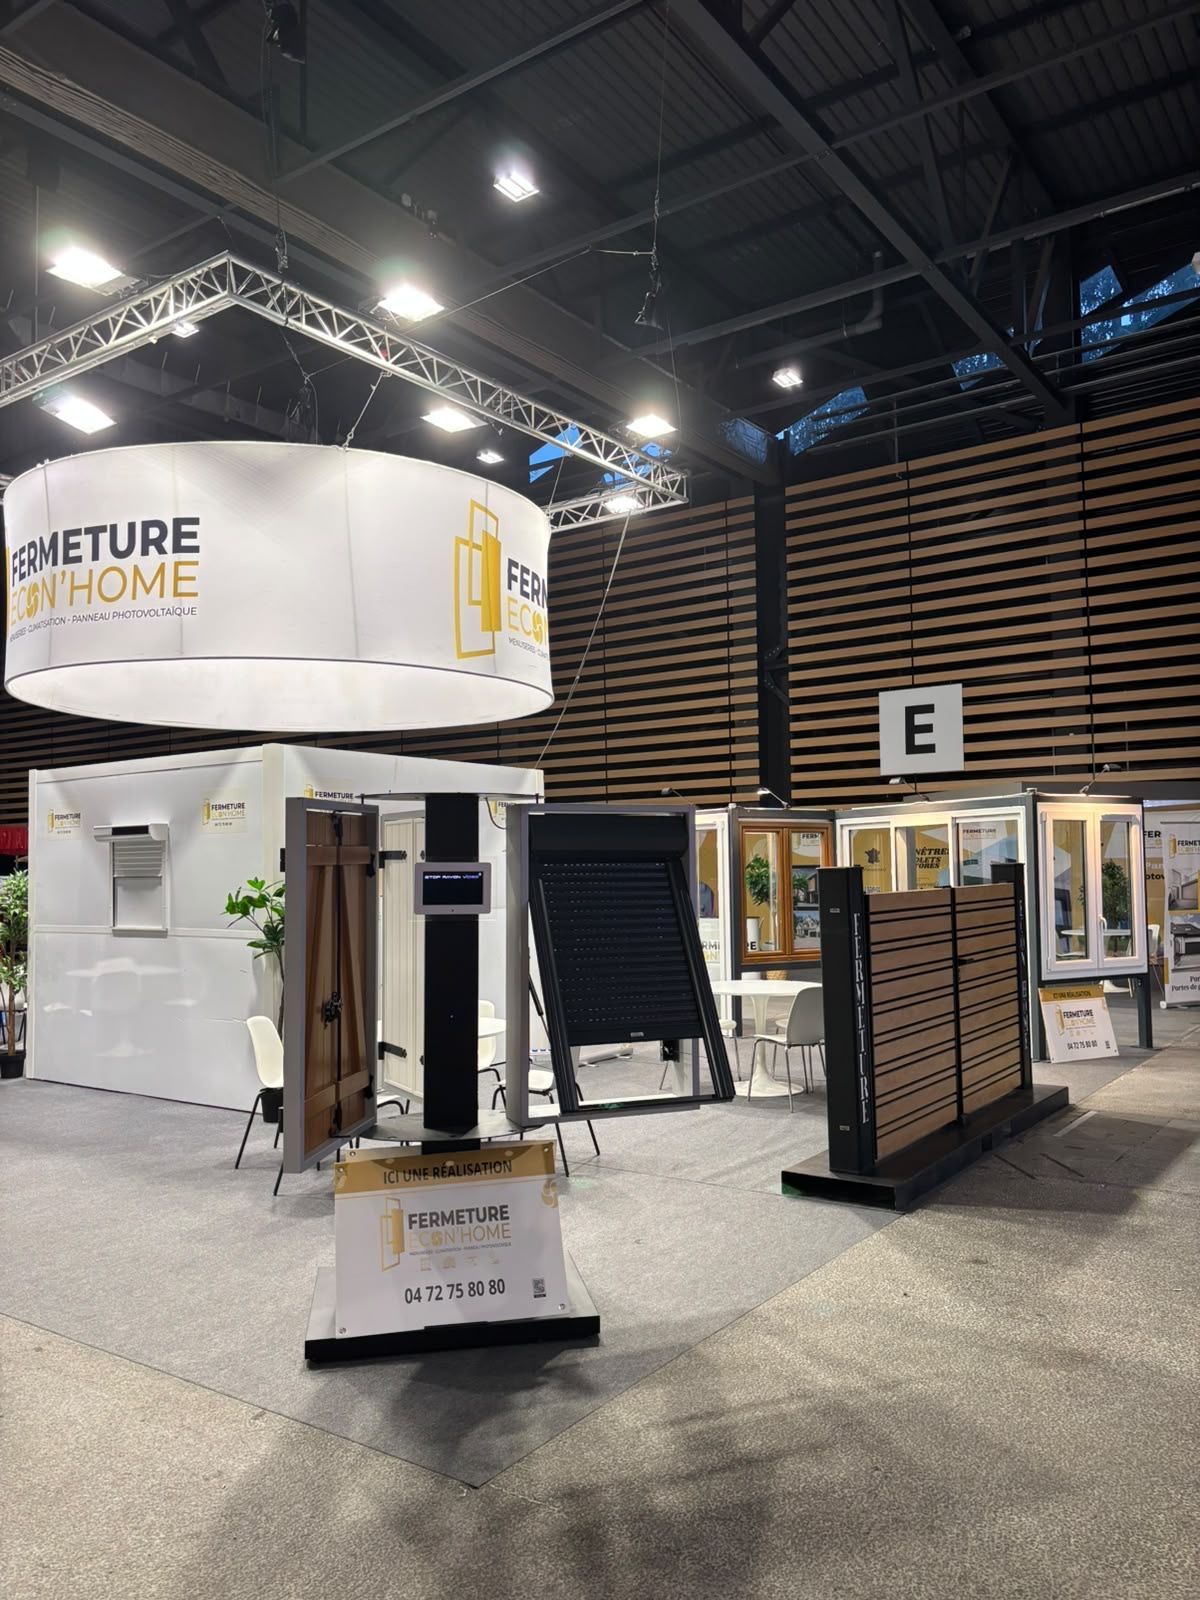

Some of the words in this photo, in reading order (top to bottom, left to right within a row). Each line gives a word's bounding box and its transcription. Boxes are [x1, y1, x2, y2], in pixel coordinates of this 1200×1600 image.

[11, 517, 200, 587] FERMETURE
[72, 612, 110, 624] PANNEAU
[112, 606, 197, 620] PHOTOVOLTAÏQUE
[905, 703, 936, 755] E
[315, 791, 354, 799] FERMETURE
[55, 812, 81, 820] FERMETURE
[211, 803, 245, 811] FERMETURE
[1063, 1009, 1094, 1018] FERMETURE
[383, 1169, 399, 1184] ICI
[402, 1167, 429, 1182] UNE
[432, 1159, 513, 1179] RÉALISATION
[408, 1204, 510, 1230] FERMETURE
[405, 1287, 422, 1304] 04
[426, 1284, 443, 1302] 72
[447, 1282, 464, 1300] 75
[468, 1280, 485, 1297] 80
[488, 1278, 506, 1295] 80
